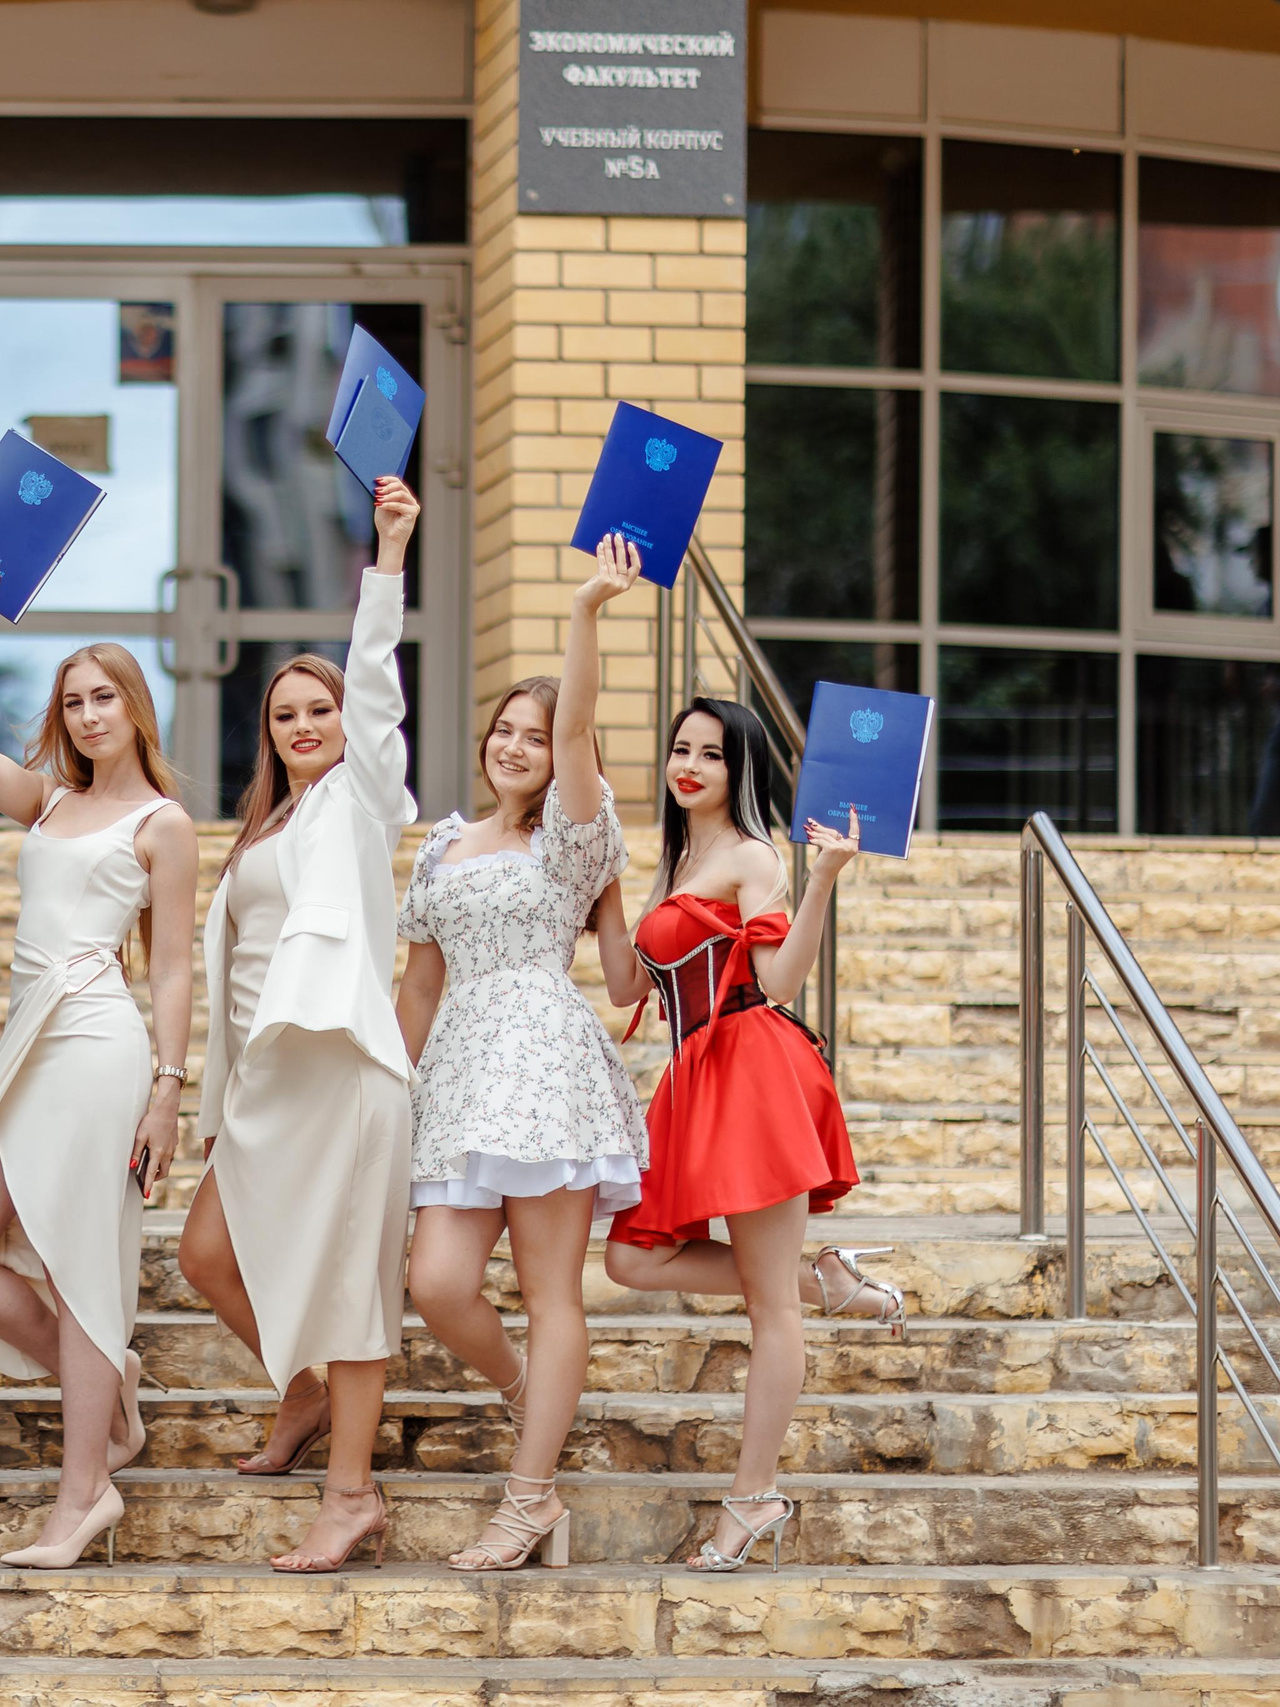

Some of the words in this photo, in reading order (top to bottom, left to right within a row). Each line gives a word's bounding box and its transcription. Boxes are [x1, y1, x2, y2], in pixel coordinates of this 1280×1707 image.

[529, 31, 735, 56] ЭКОНОМИЧЕСКИЙ
[562, 65, 700, 88] ФАКУЛЬТЕТ
[539, 125, 641, 148] УЧЕБНЫЙ
[643, 130, 723, 150] КОРПУС
